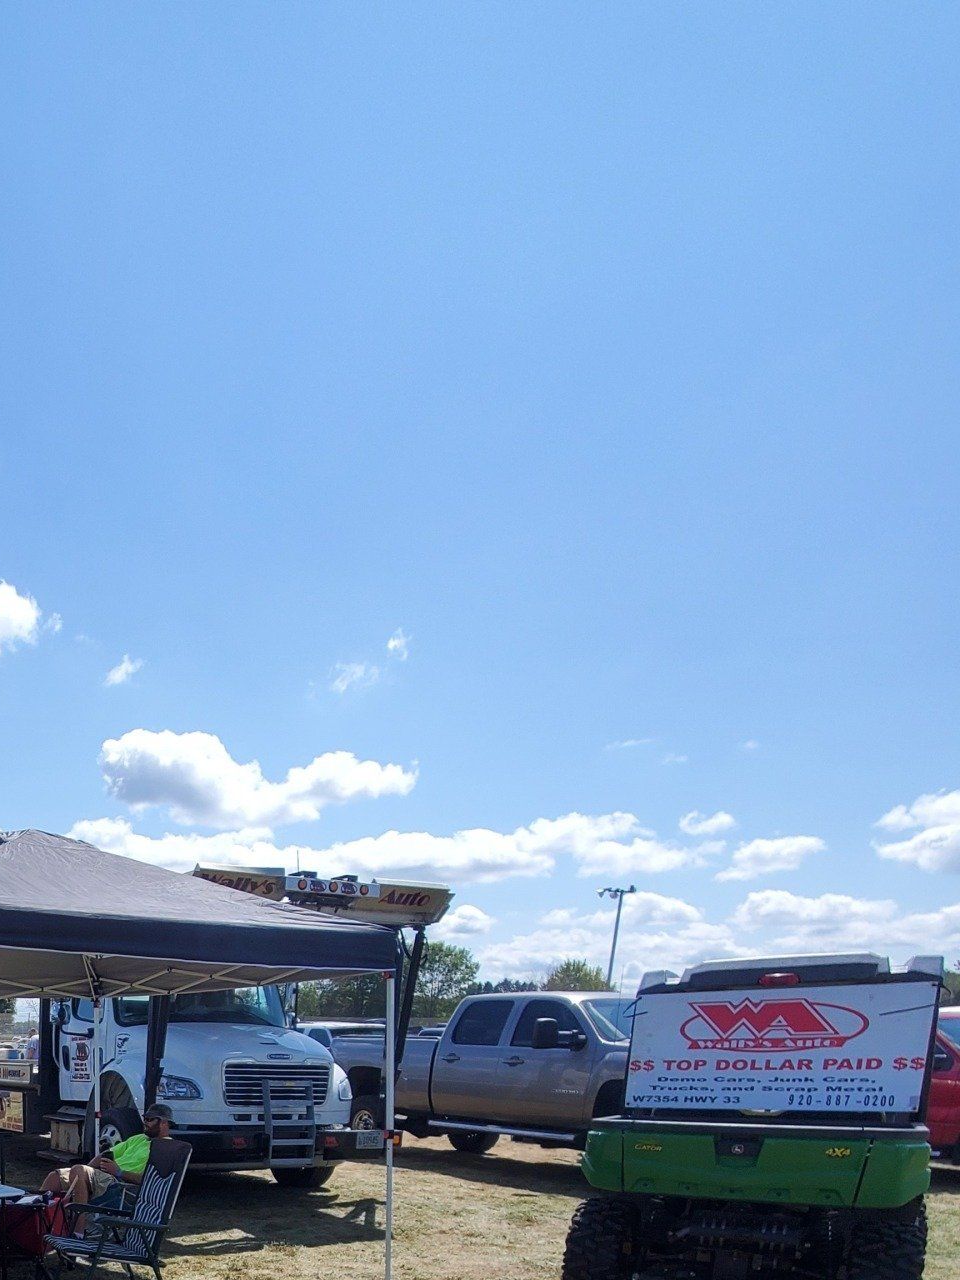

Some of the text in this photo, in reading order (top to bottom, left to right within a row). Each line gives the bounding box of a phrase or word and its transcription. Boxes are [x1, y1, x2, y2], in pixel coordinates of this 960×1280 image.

[379, 889, 431, 907] Auto
[697, 1036, 838, 1050] Wally's Auto
[629, 1056, 926, 1073] $$ TOP DOLLAR PAID $$
[714, 1076, 762, 1084] Cars,
[822, 1076, 876, 1084] Cars,
[648, 1084, 715, 1092] Trucks,
[761, 1085, 819, 1093] Scrap
[632, 1095, 679, 1103] W7354
[723, 1095, 741, 1104] 33
[634, 1143, 663, 1152] GATOR
